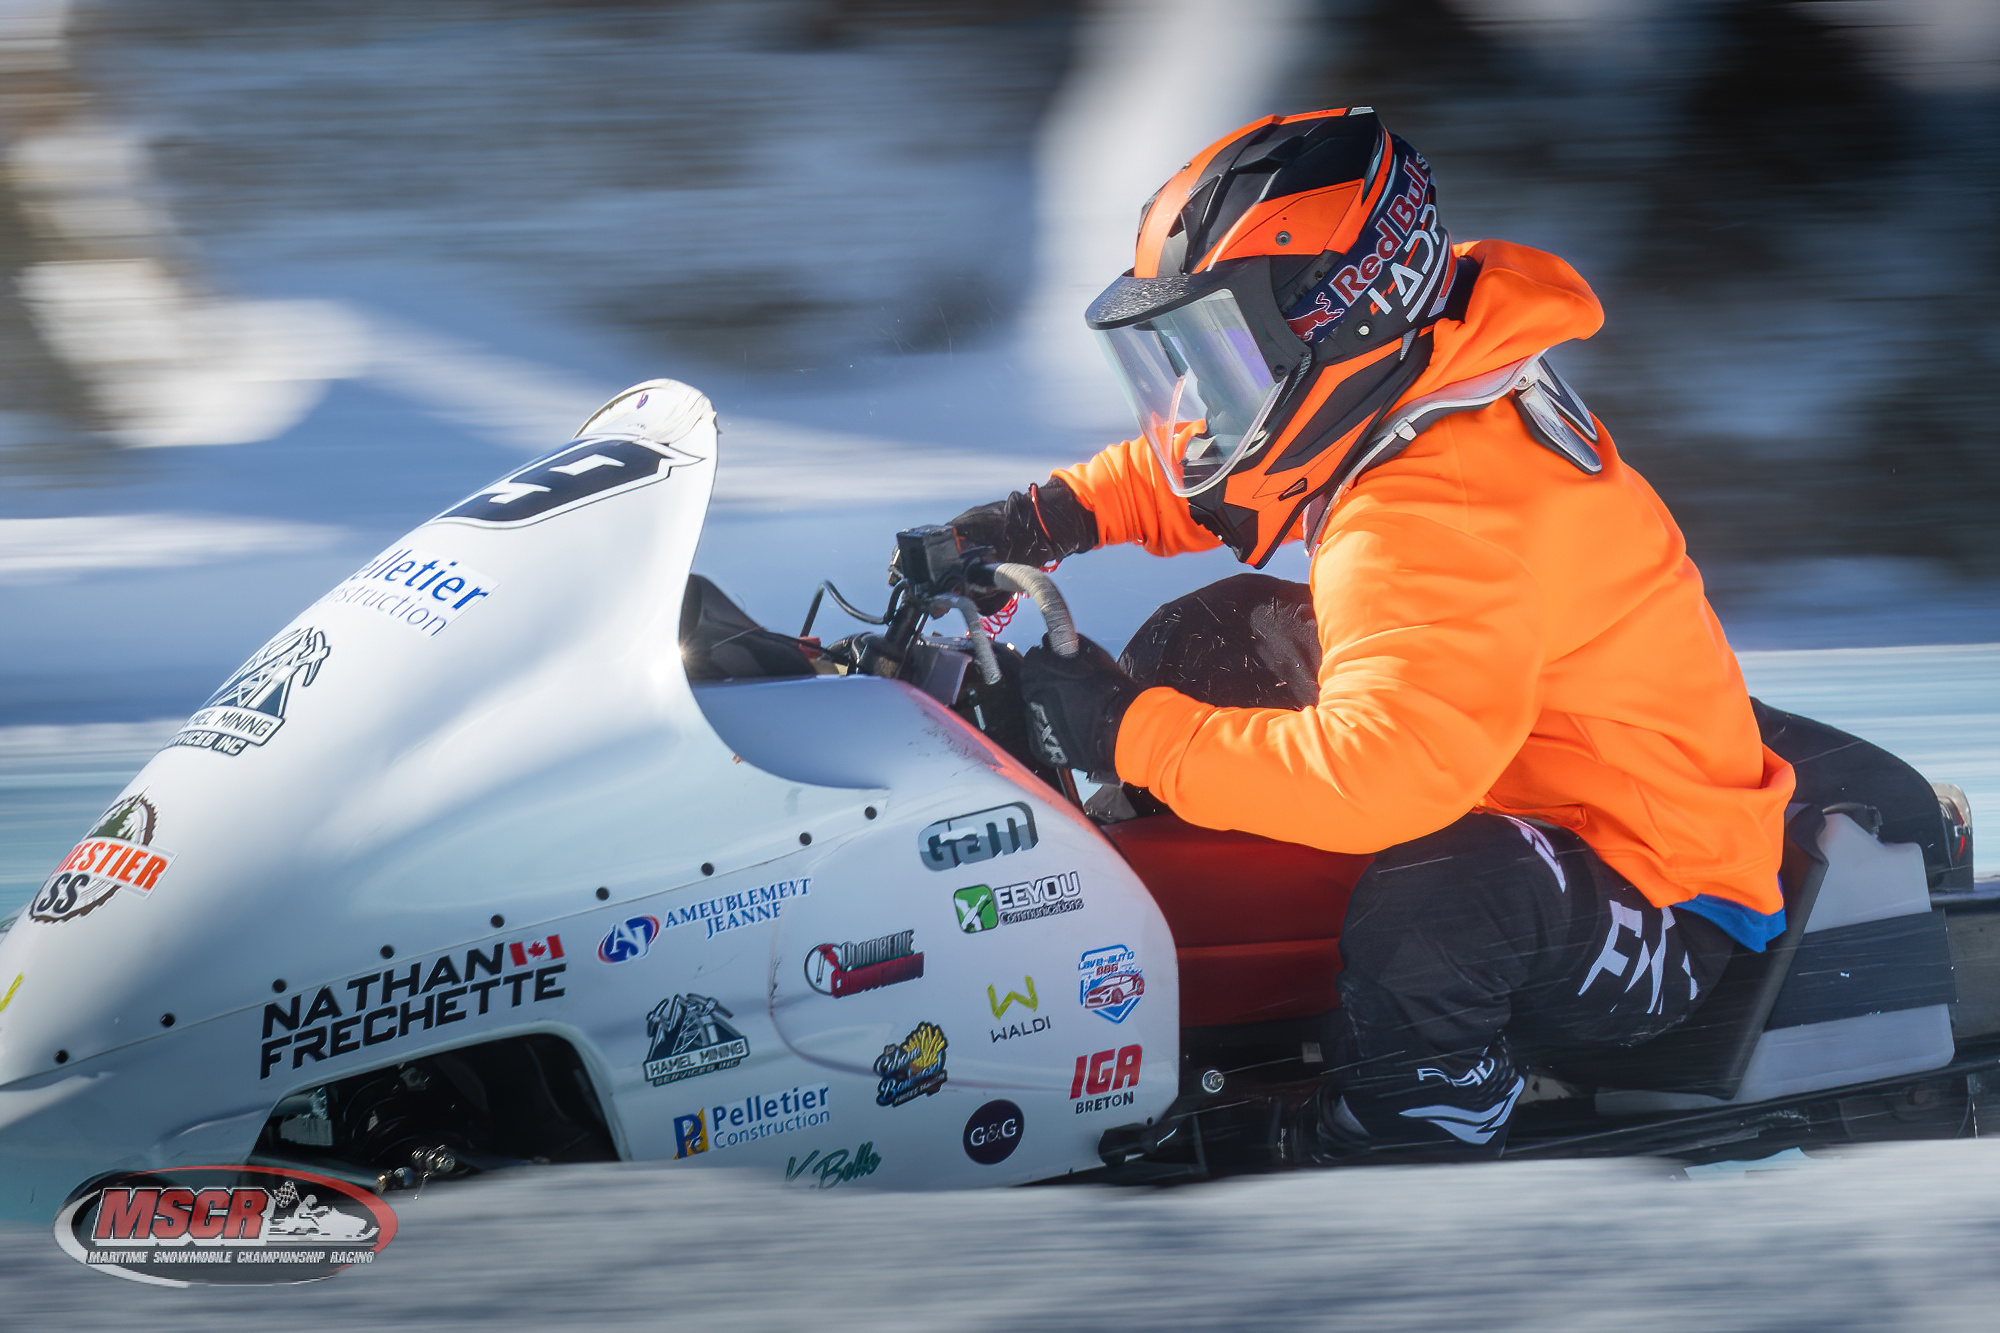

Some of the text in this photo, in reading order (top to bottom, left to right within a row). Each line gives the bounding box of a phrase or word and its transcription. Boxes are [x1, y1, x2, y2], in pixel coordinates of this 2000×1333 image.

[1328, 155, 1429, 307] Red Bull
[350, 549, 490, 611] elletier
[330, 584, 448, 638] nstruction
[214, 710, 274, 738] MINING
[213, 734, 250, 757] INC
[665, 878, 812, 929] AMEUBLEMENT
[706, 901, 782, 940] JEANNE
[999, 898, 1084, 925] Communications
[261, 942, 505, 1040] NATHAN
[259, 962, 567, 1081] FRECHETTE
[990, 1016, 1051, 1044] WALDI
[649, 1040, 744, 1077] HAMEL MINING
[1069, 1044, 1142, 1100] IGA
[712, 1086, 829, 1132] Pelletier
[1075, 1091, 1134, 1115] BRETON
[714, 1110, 831, 1149] Construction
[970, 1118, 1018, 1146] G&G
